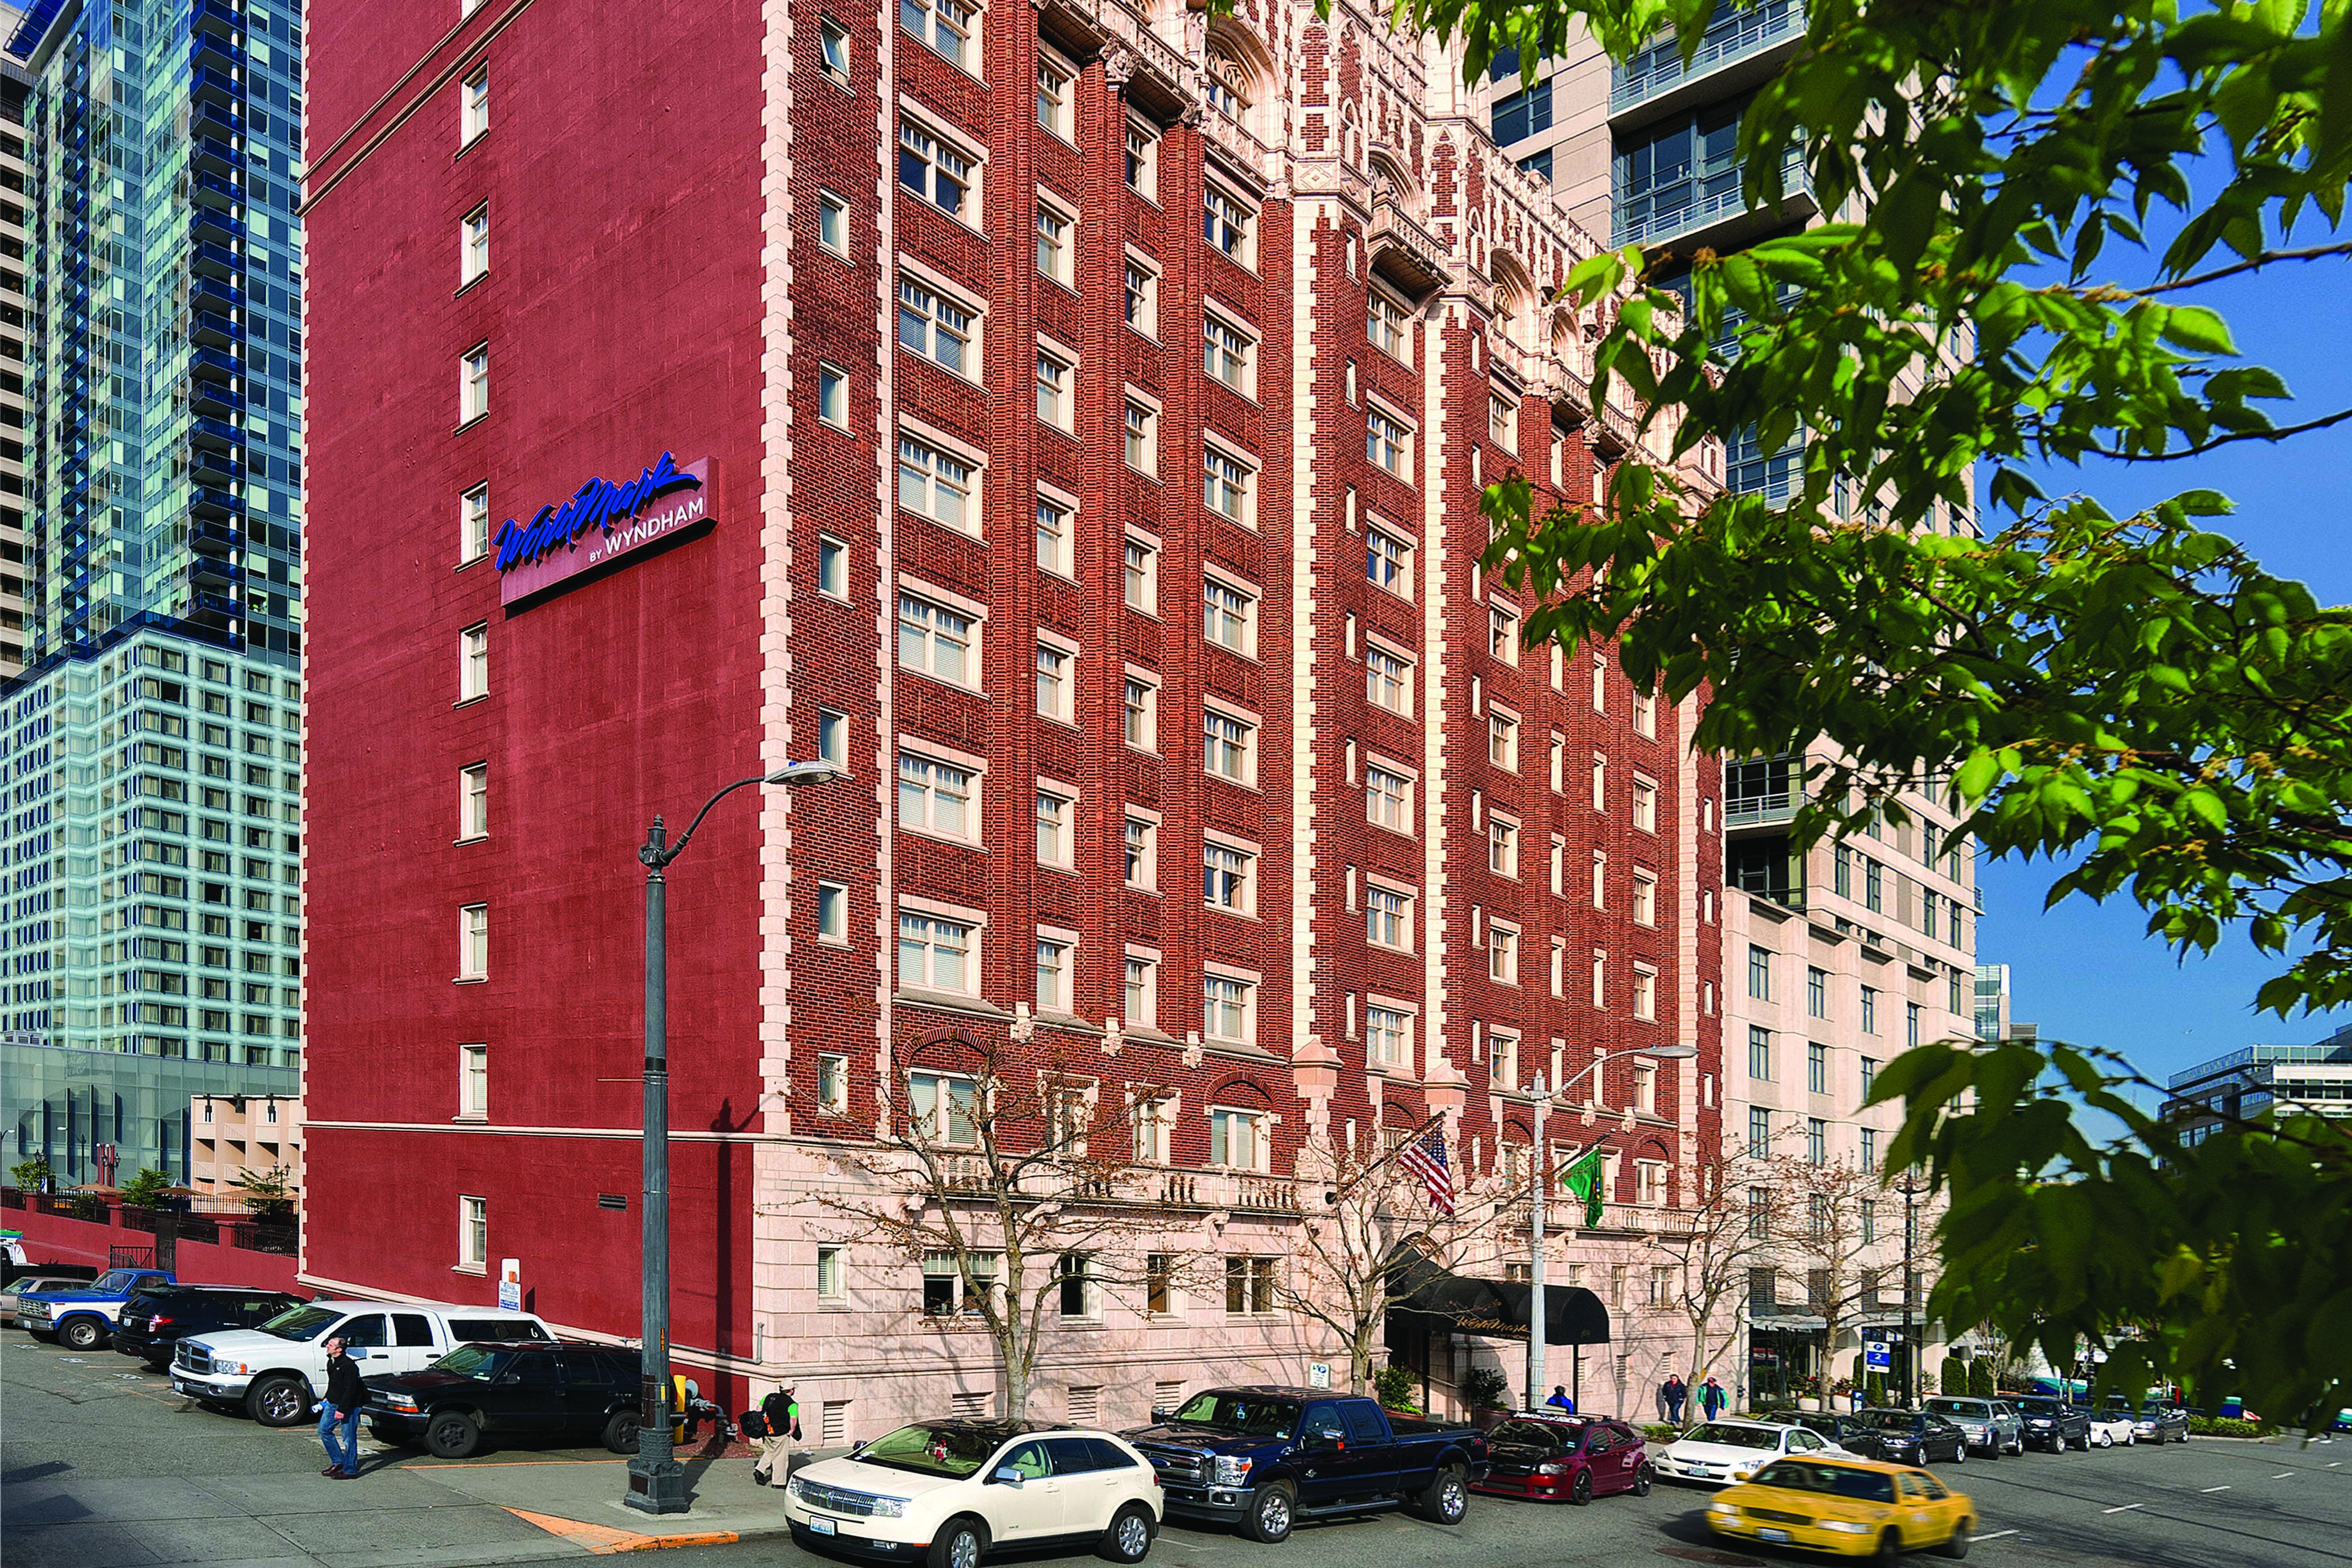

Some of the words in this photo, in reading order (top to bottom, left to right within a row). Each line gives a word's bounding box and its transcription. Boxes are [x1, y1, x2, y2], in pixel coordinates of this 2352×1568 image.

[491, 450, 698, 570] WorldMark
[589, 549, 603, 563] BY
[605, 497, 704, 555] WYNDHAM
